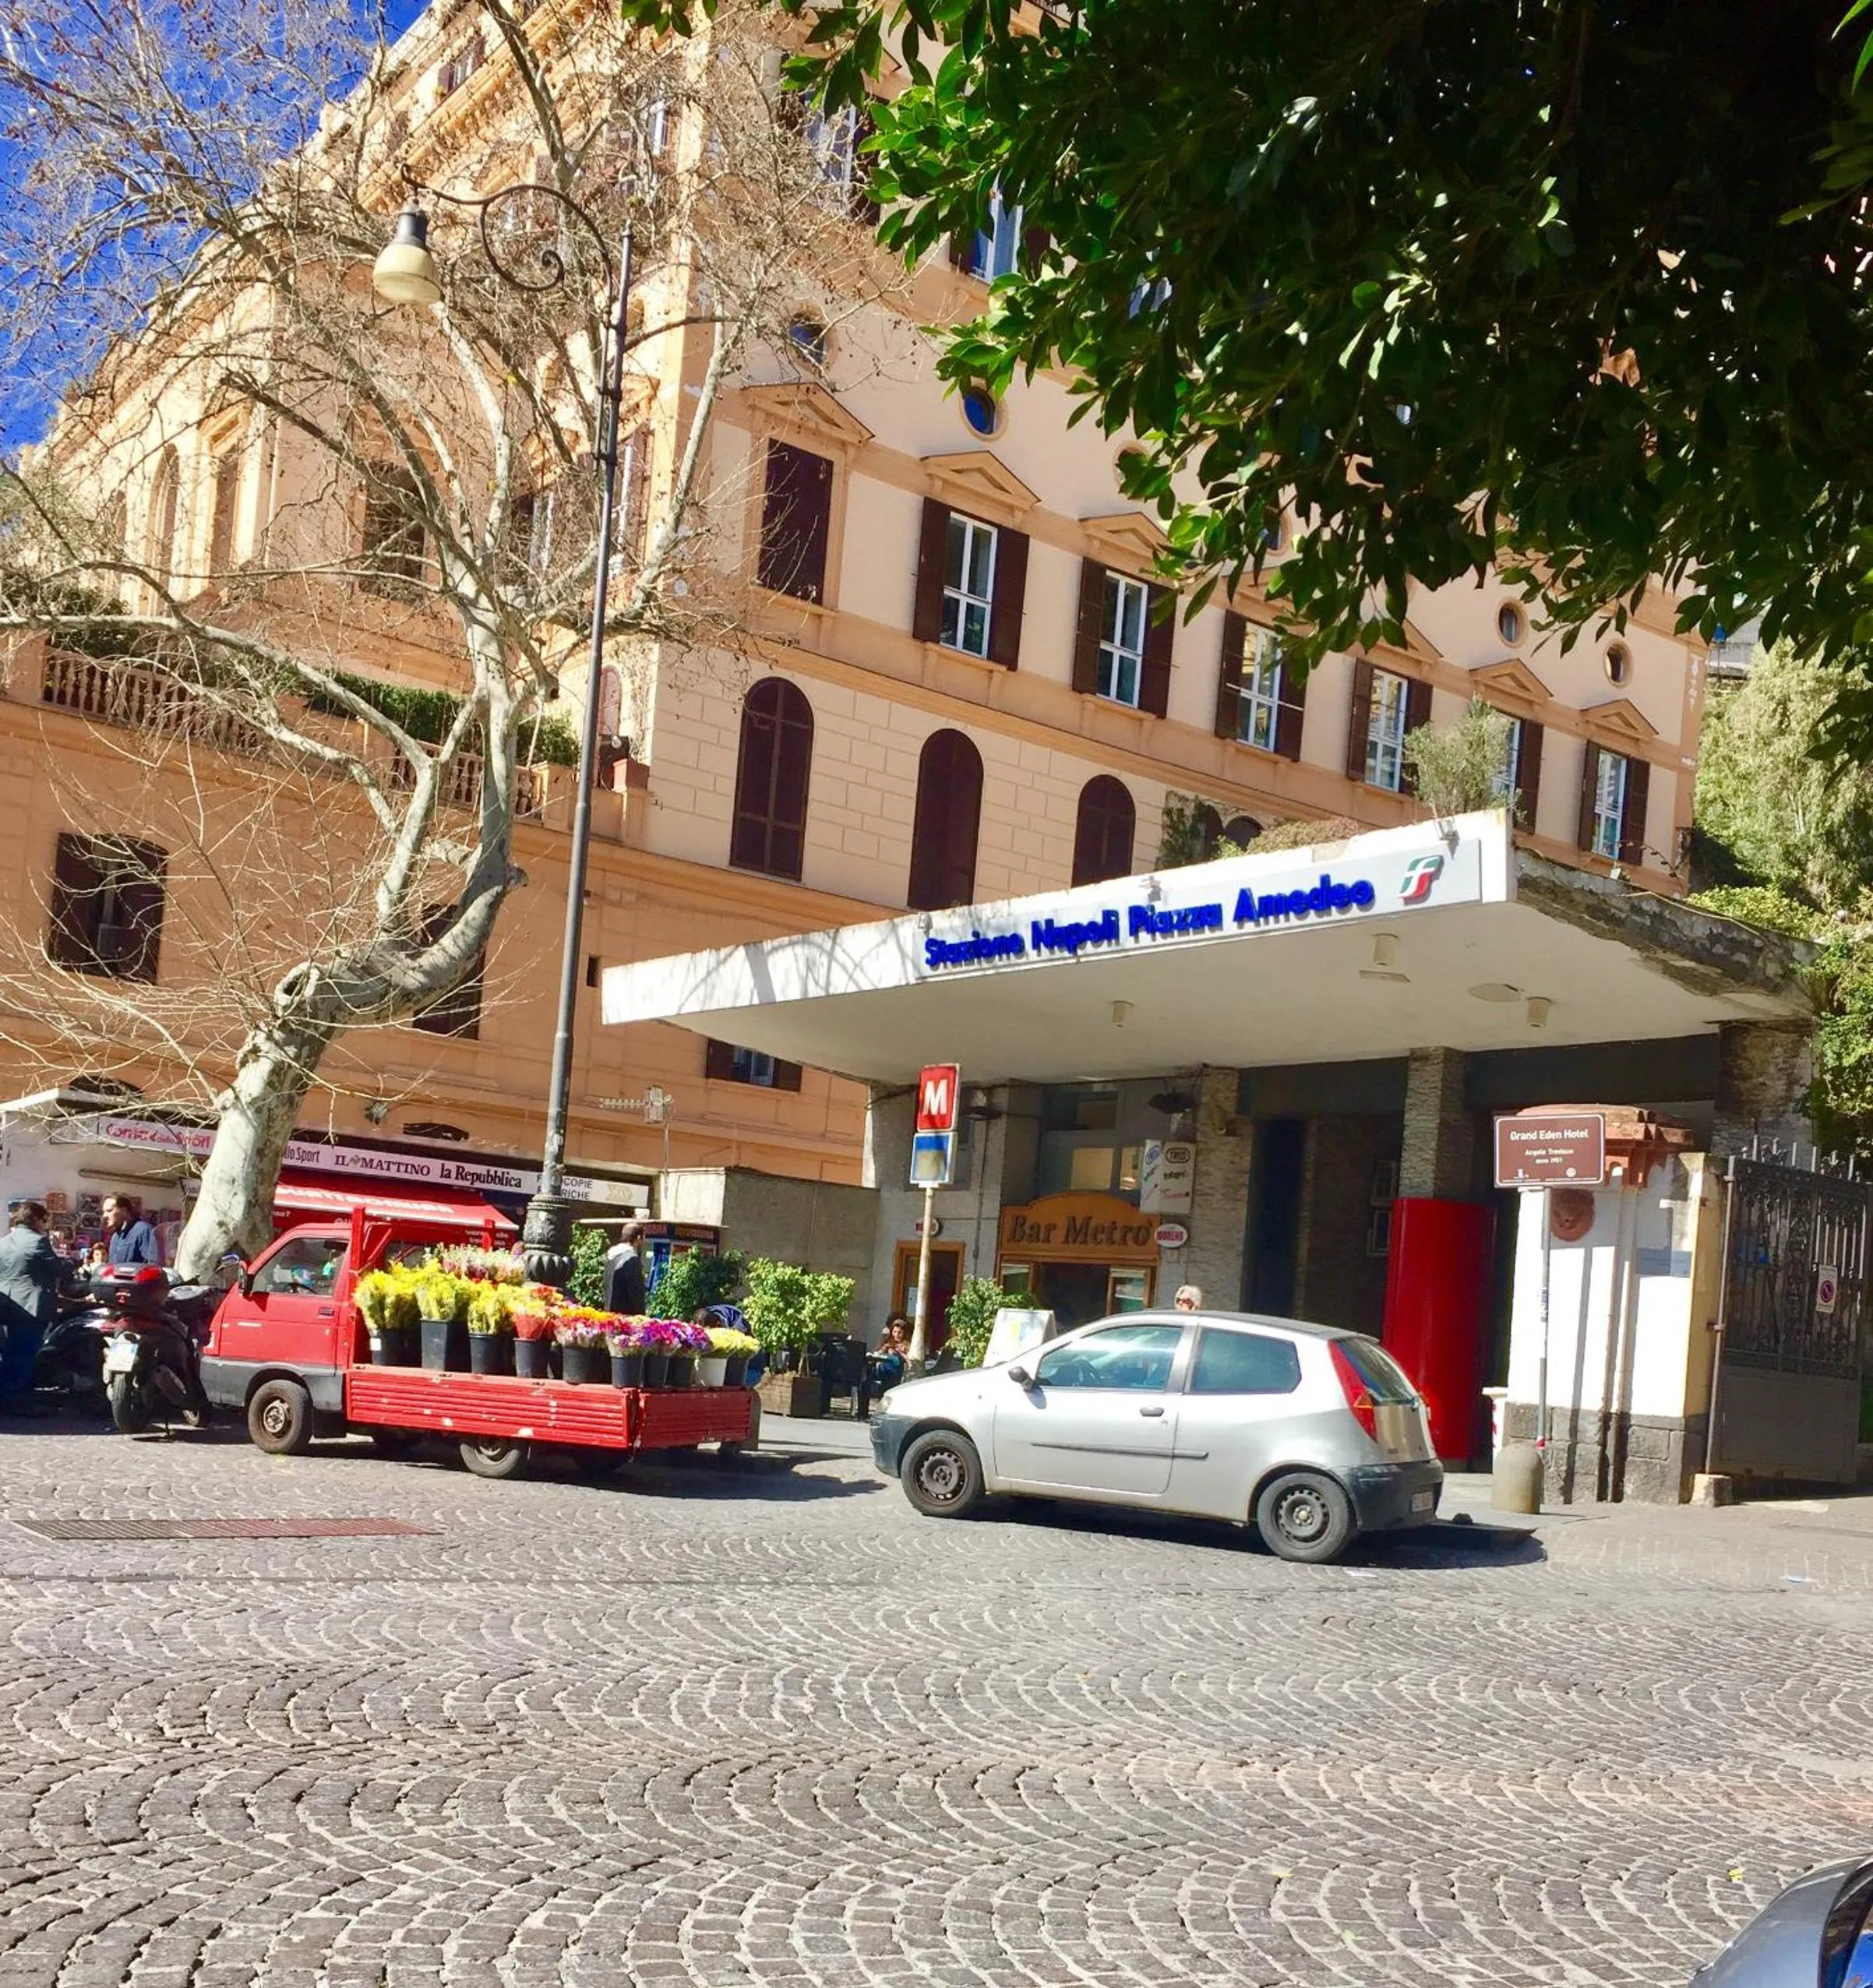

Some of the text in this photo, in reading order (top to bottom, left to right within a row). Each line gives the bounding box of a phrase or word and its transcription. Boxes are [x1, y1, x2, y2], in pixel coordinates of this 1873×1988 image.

[925, 875, 1374, 966] Stazione Napoli Piazza Amedeo
[922, 1079, 947, 1116] M
[1510, 1128, 1589, 1140] Grand Eden Hotel
[295, 1147, 320, 1164] Sport
[335, 1154, 431, 1176] IL MATTINO
[439, 1163, 522, 1188] la Repubblica
[1007, 1214, 1056, 1244] Bar
